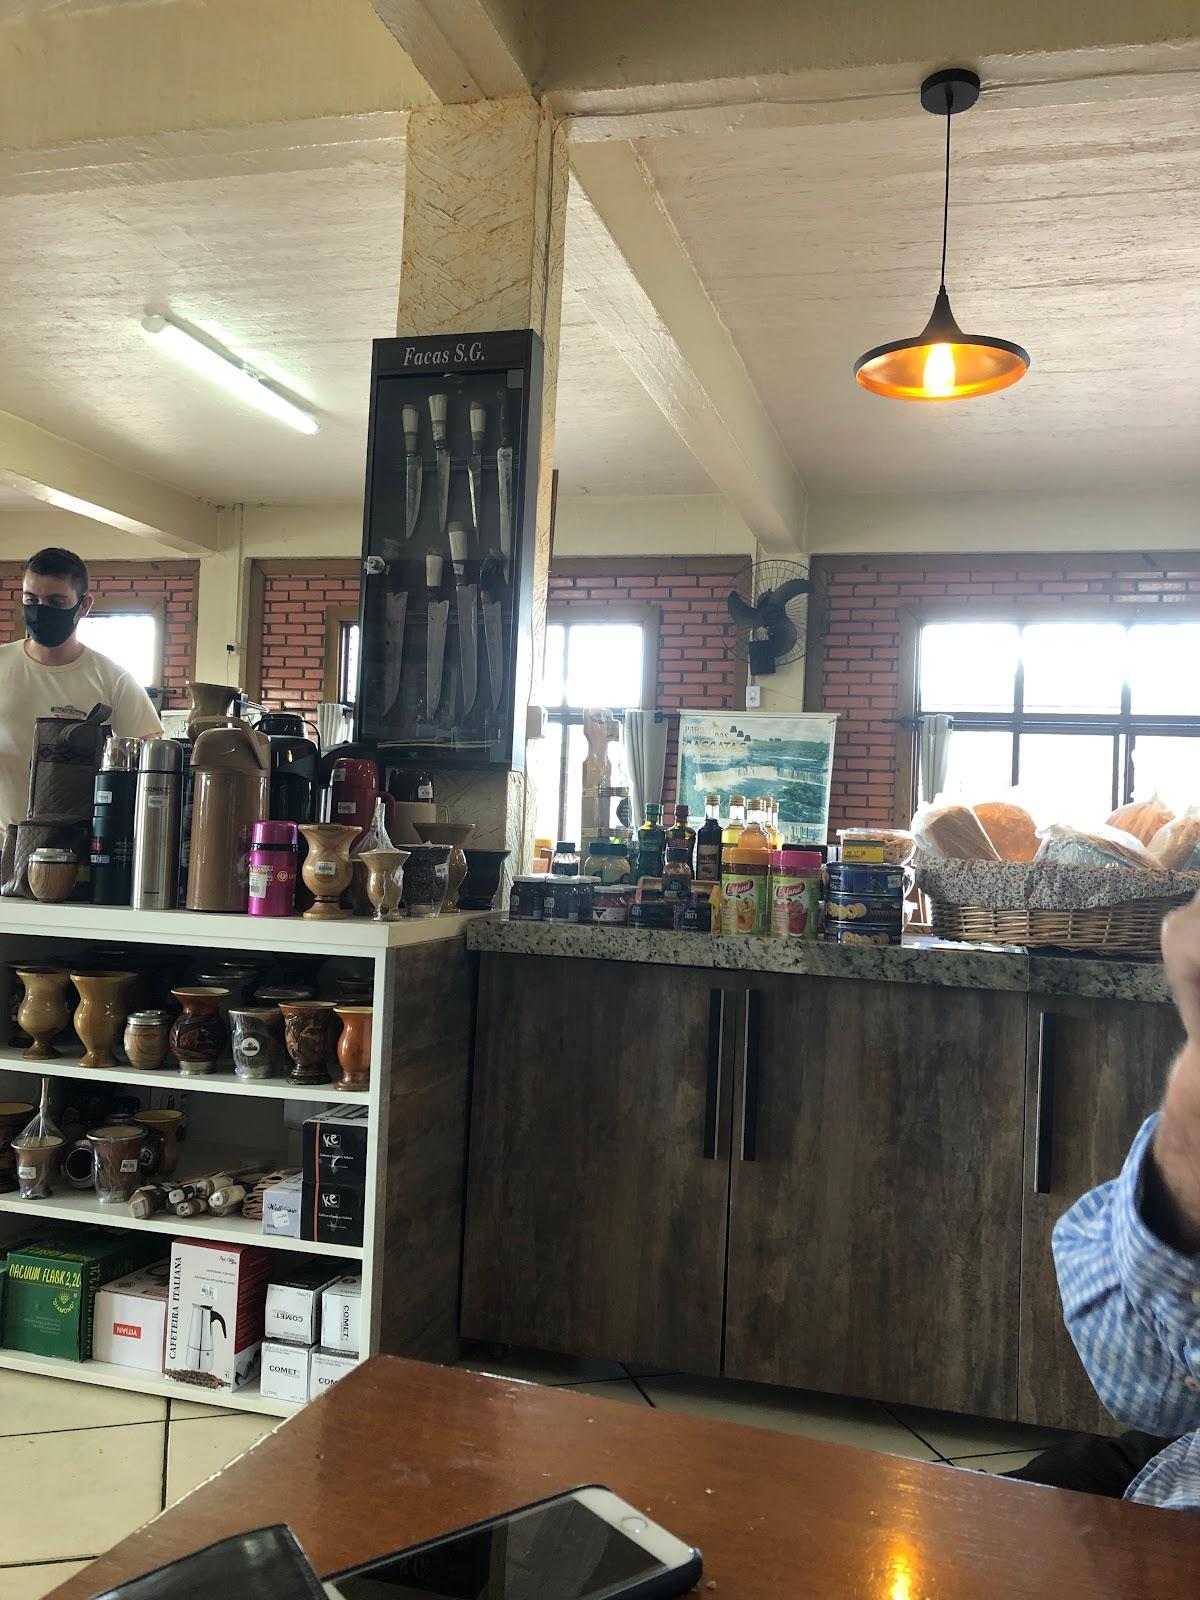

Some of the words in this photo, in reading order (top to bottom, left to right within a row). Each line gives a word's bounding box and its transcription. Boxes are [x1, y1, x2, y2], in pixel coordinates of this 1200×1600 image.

[403, 345, 450, 366] Facas
[453, 342, 484, 363] S.G.
[9, 1263, 41, 1281] VACUUM
[42, 1268, 66, 1285] FLASK
[173, 1256, 182, 1303] ITALIANA
[276, 1313, 304, 1322] COMET
[169, 1306, 180, 1360] CAFETEIRA
[269, 1365, 298, 1375] COMET
